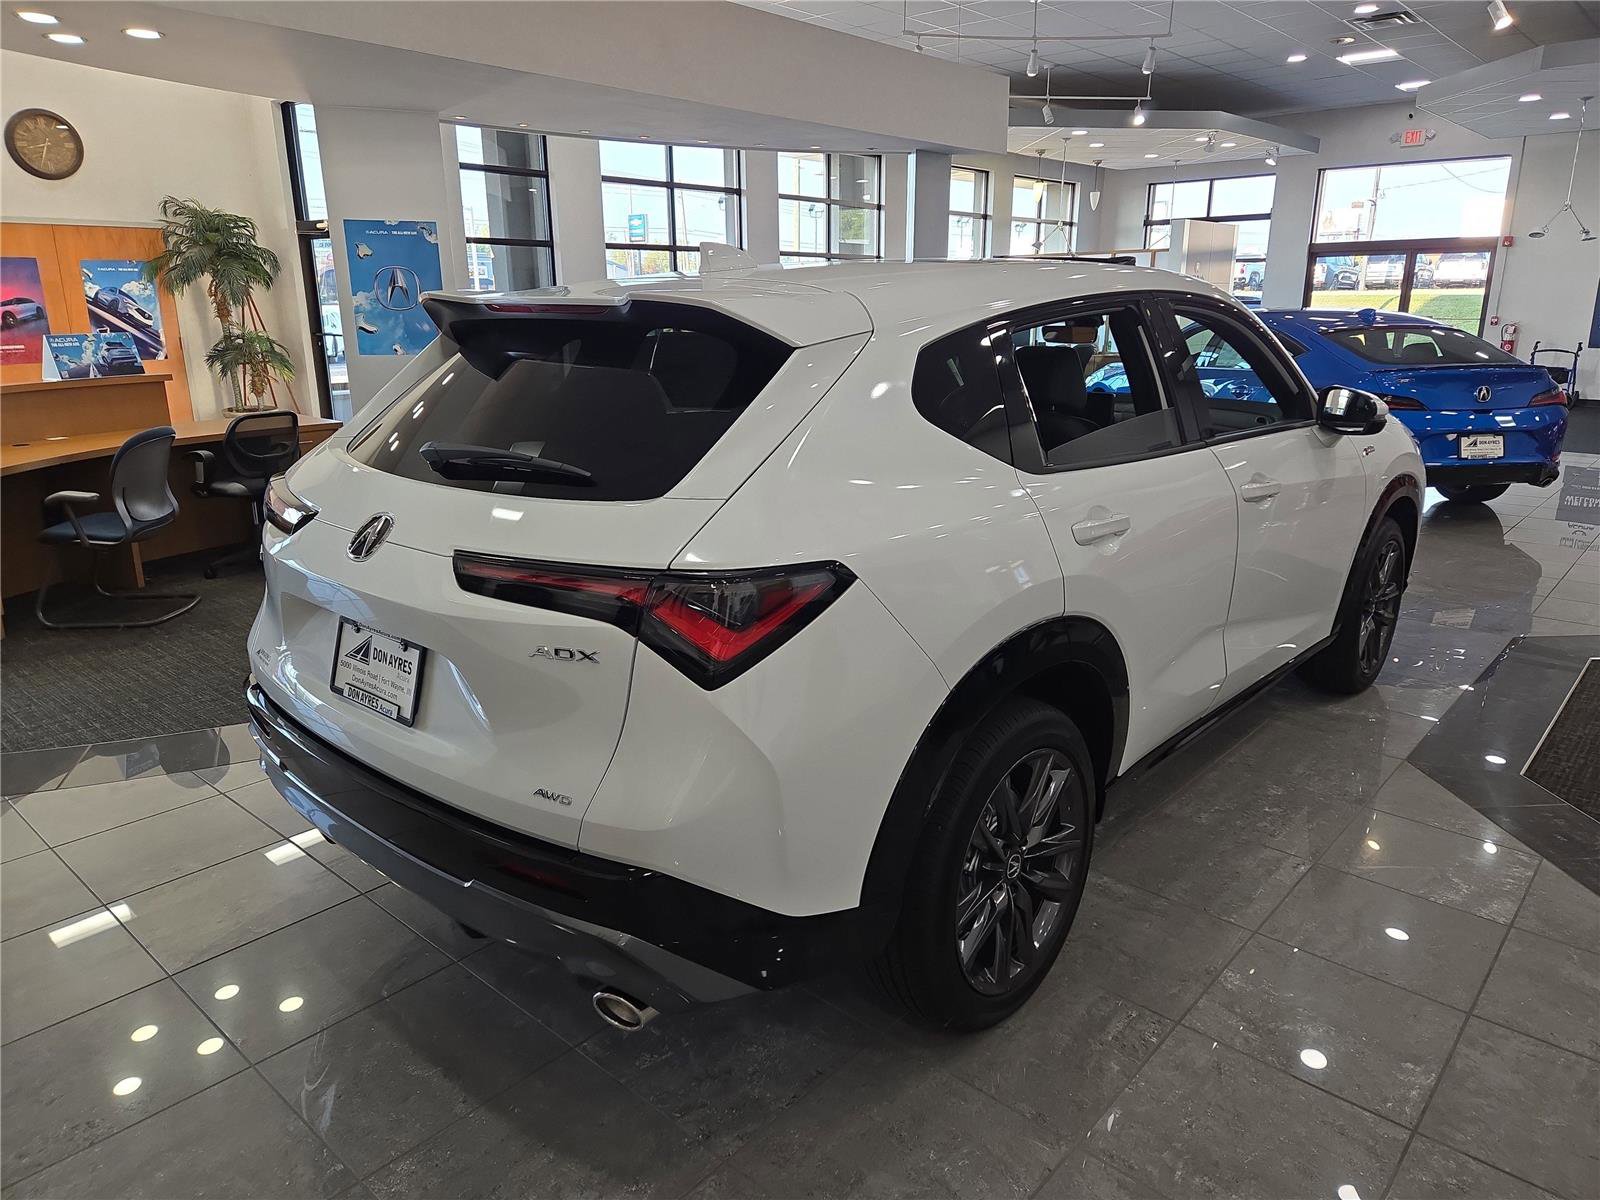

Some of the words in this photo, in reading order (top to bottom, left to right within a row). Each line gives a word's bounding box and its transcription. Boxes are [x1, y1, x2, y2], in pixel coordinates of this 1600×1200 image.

[1405, 130, 1424, 143] EXIT
[372, 647, 388, 666] DON
[387, 653, 413, 676] AYRES
[528, 645, 600, 664] ADX
[340, 659, 352, 670] 5000
[352, 663, 367, 676] Illinois
[367, 670, 378, 681] Road
[381, 676, 390, 686] Fort
[351, 674, 398, 701] DonAyresAcura.com
[347, 686, 361, 700] DON
[360, 692, 379, 710] AYRES
[379, 703, 393, 717] Acura
[533, 788, 573, 806] AWD
